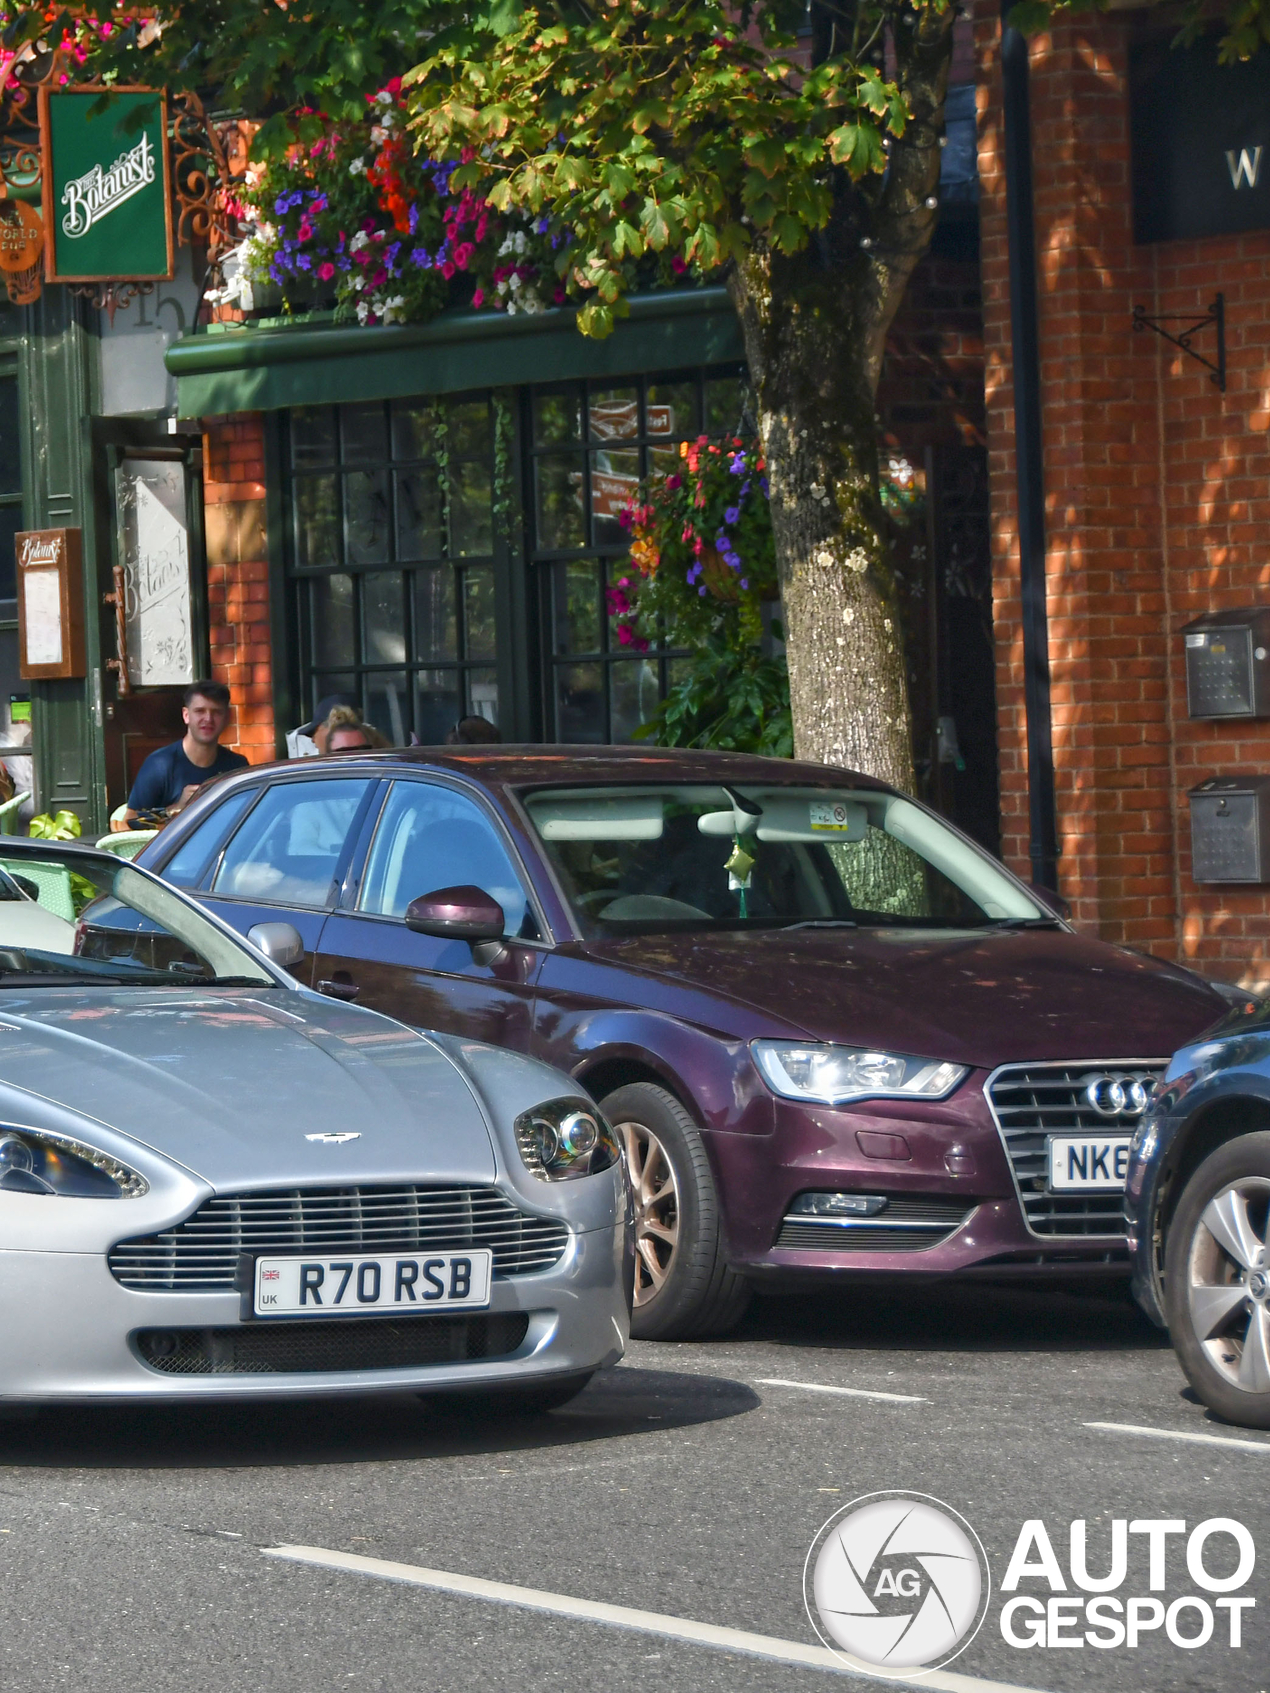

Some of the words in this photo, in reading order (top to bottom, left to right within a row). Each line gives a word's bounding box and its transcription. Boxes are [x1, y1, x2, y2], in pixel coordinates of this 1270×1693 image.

[61, 131, 155, 238] Botanist
[262, 1294, 278, 1305] UK
[298, 1261, 381, 1306] R70
[394, 1257, 472, 1302] RSB
